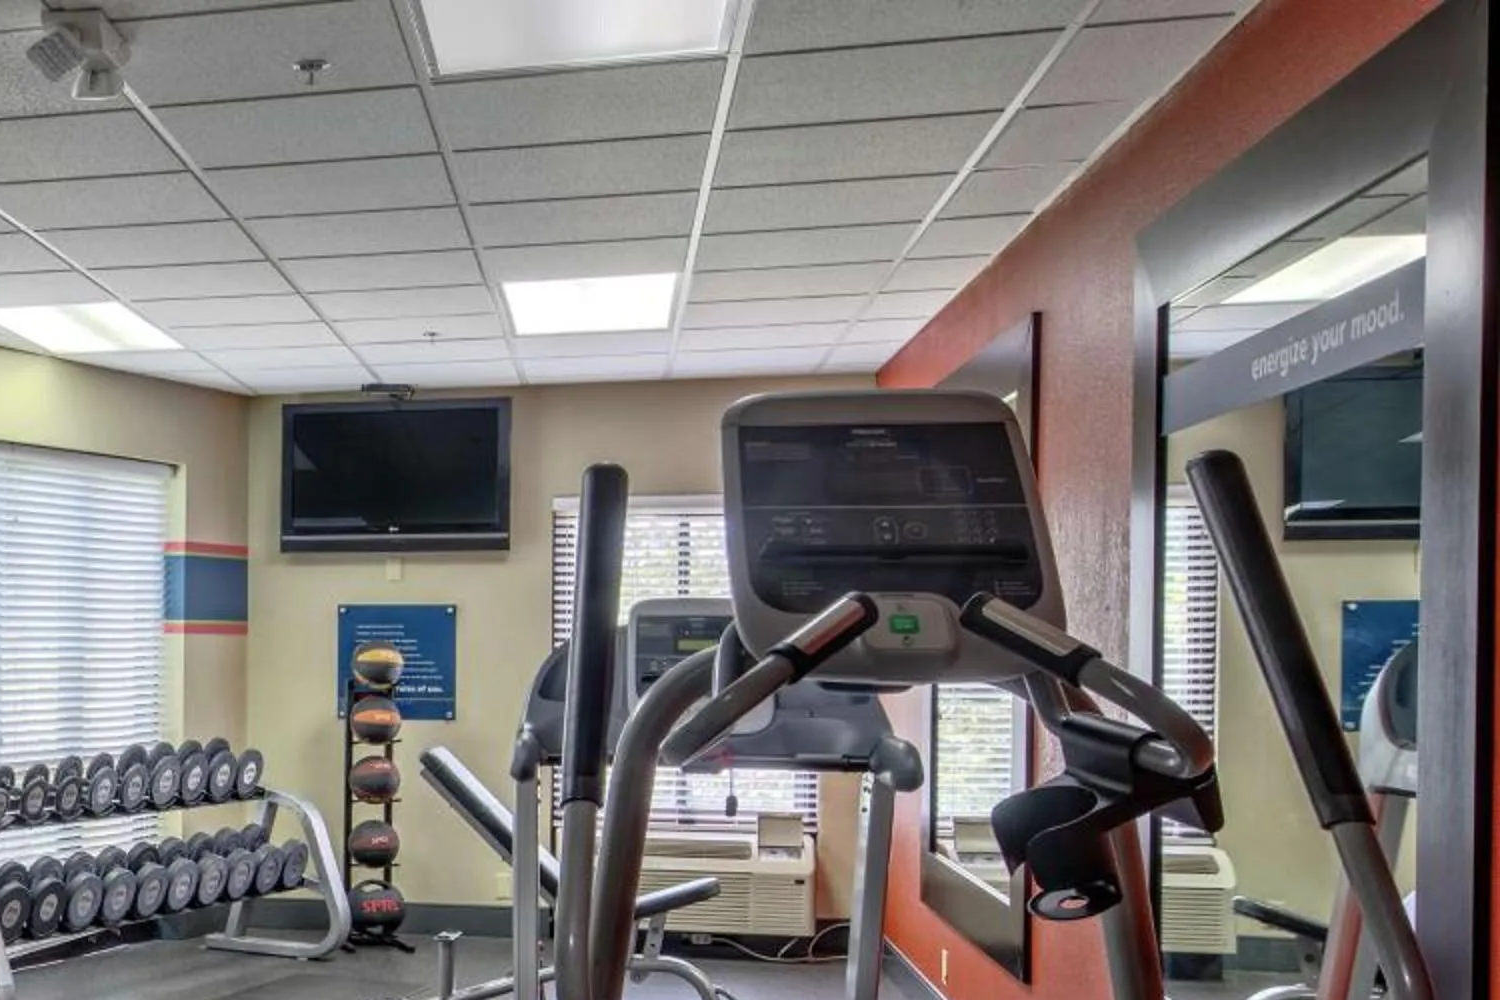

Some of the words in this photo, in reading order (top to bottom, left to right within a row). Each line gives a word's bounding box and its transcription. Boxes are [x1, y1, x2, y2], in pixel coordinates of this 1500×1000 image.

[1251, 337, 1308, 380] energize
[1310, 321, 1347, 365] your
[1350, 289, 1405, 340] mood.
